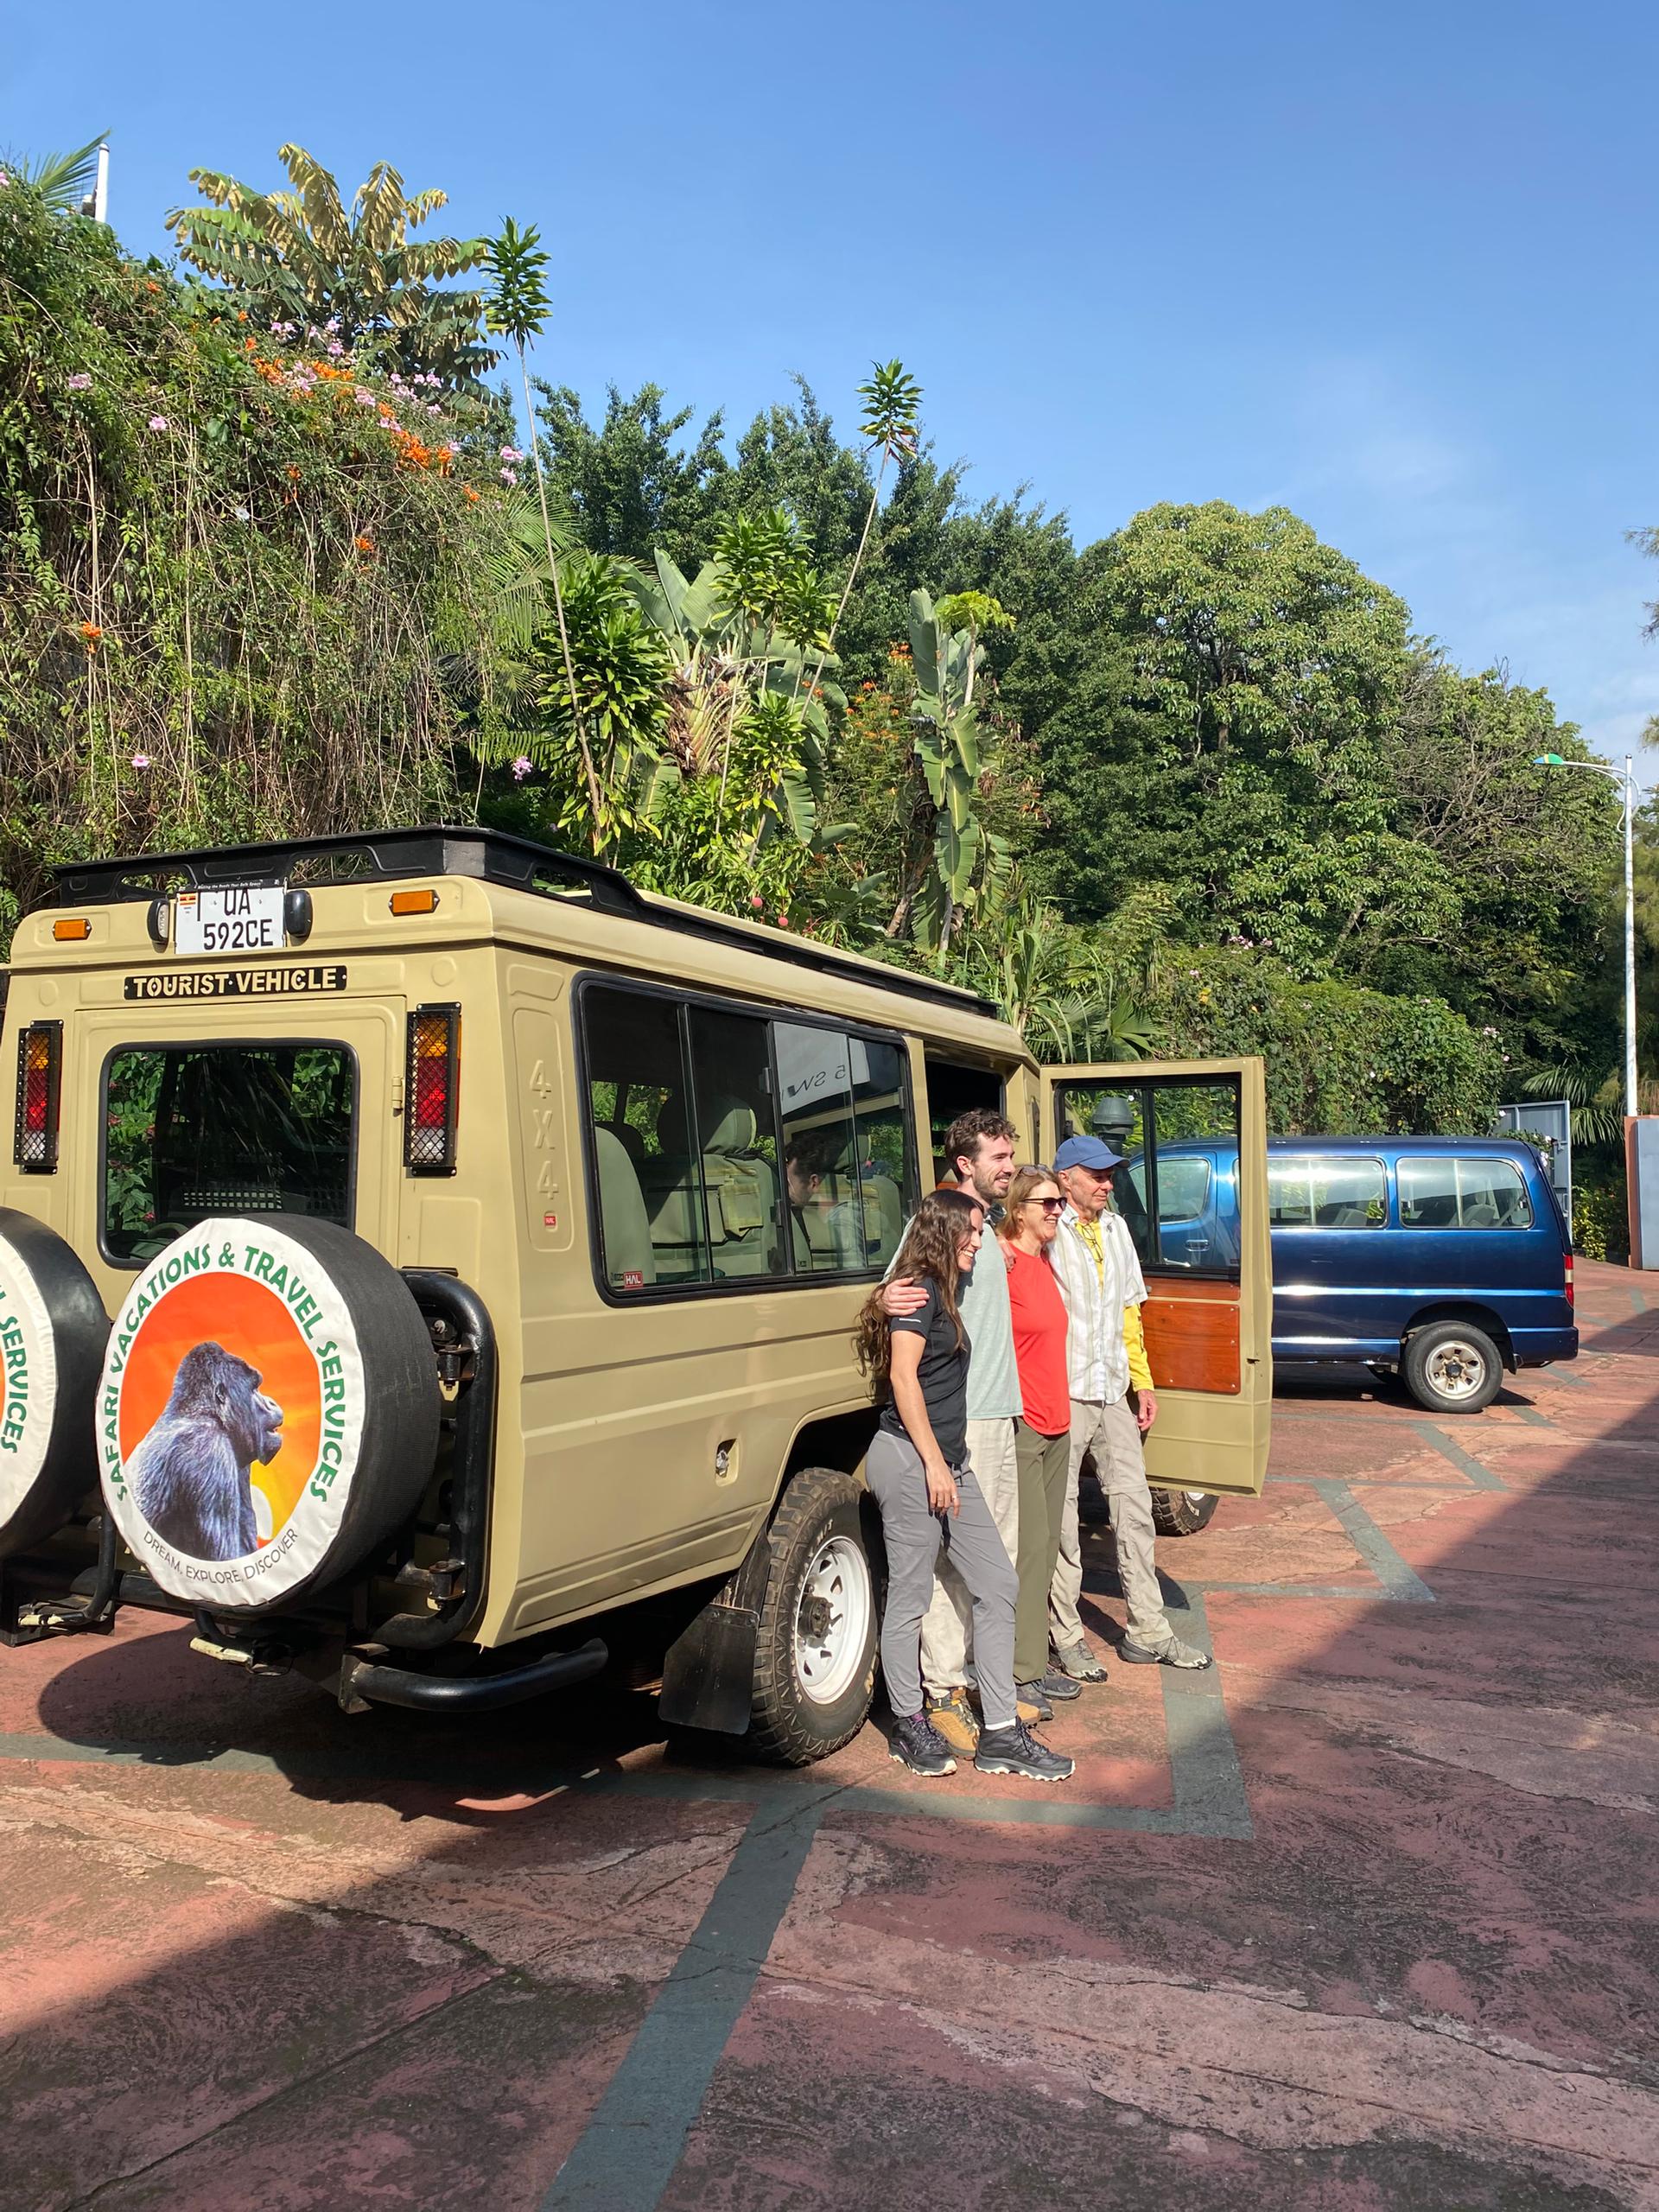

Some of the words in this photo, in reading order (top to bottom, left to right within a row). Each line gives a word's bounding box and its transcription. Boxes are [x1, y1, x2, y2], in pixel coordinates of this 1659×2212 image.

[203, 918, 274, 950] 592CE
[225, 888, 251, 917] UA
[133, 973, 230, 998] TOURIST
[235, 967, 337, 994] VEHICLE
[218, 1242, 235, 1268] &
[110, 1243, 211, 1374] VACATIONS
[244, 1245, 324, 1341] TRAVEL
[0, 1316, 29, 1454] SERVICES
[309, 1340, 346, 1503] SERVICES
[105, 1384, 128, 1502] SAFARI
[244, 1528, 299, 1580] DISCOVER
